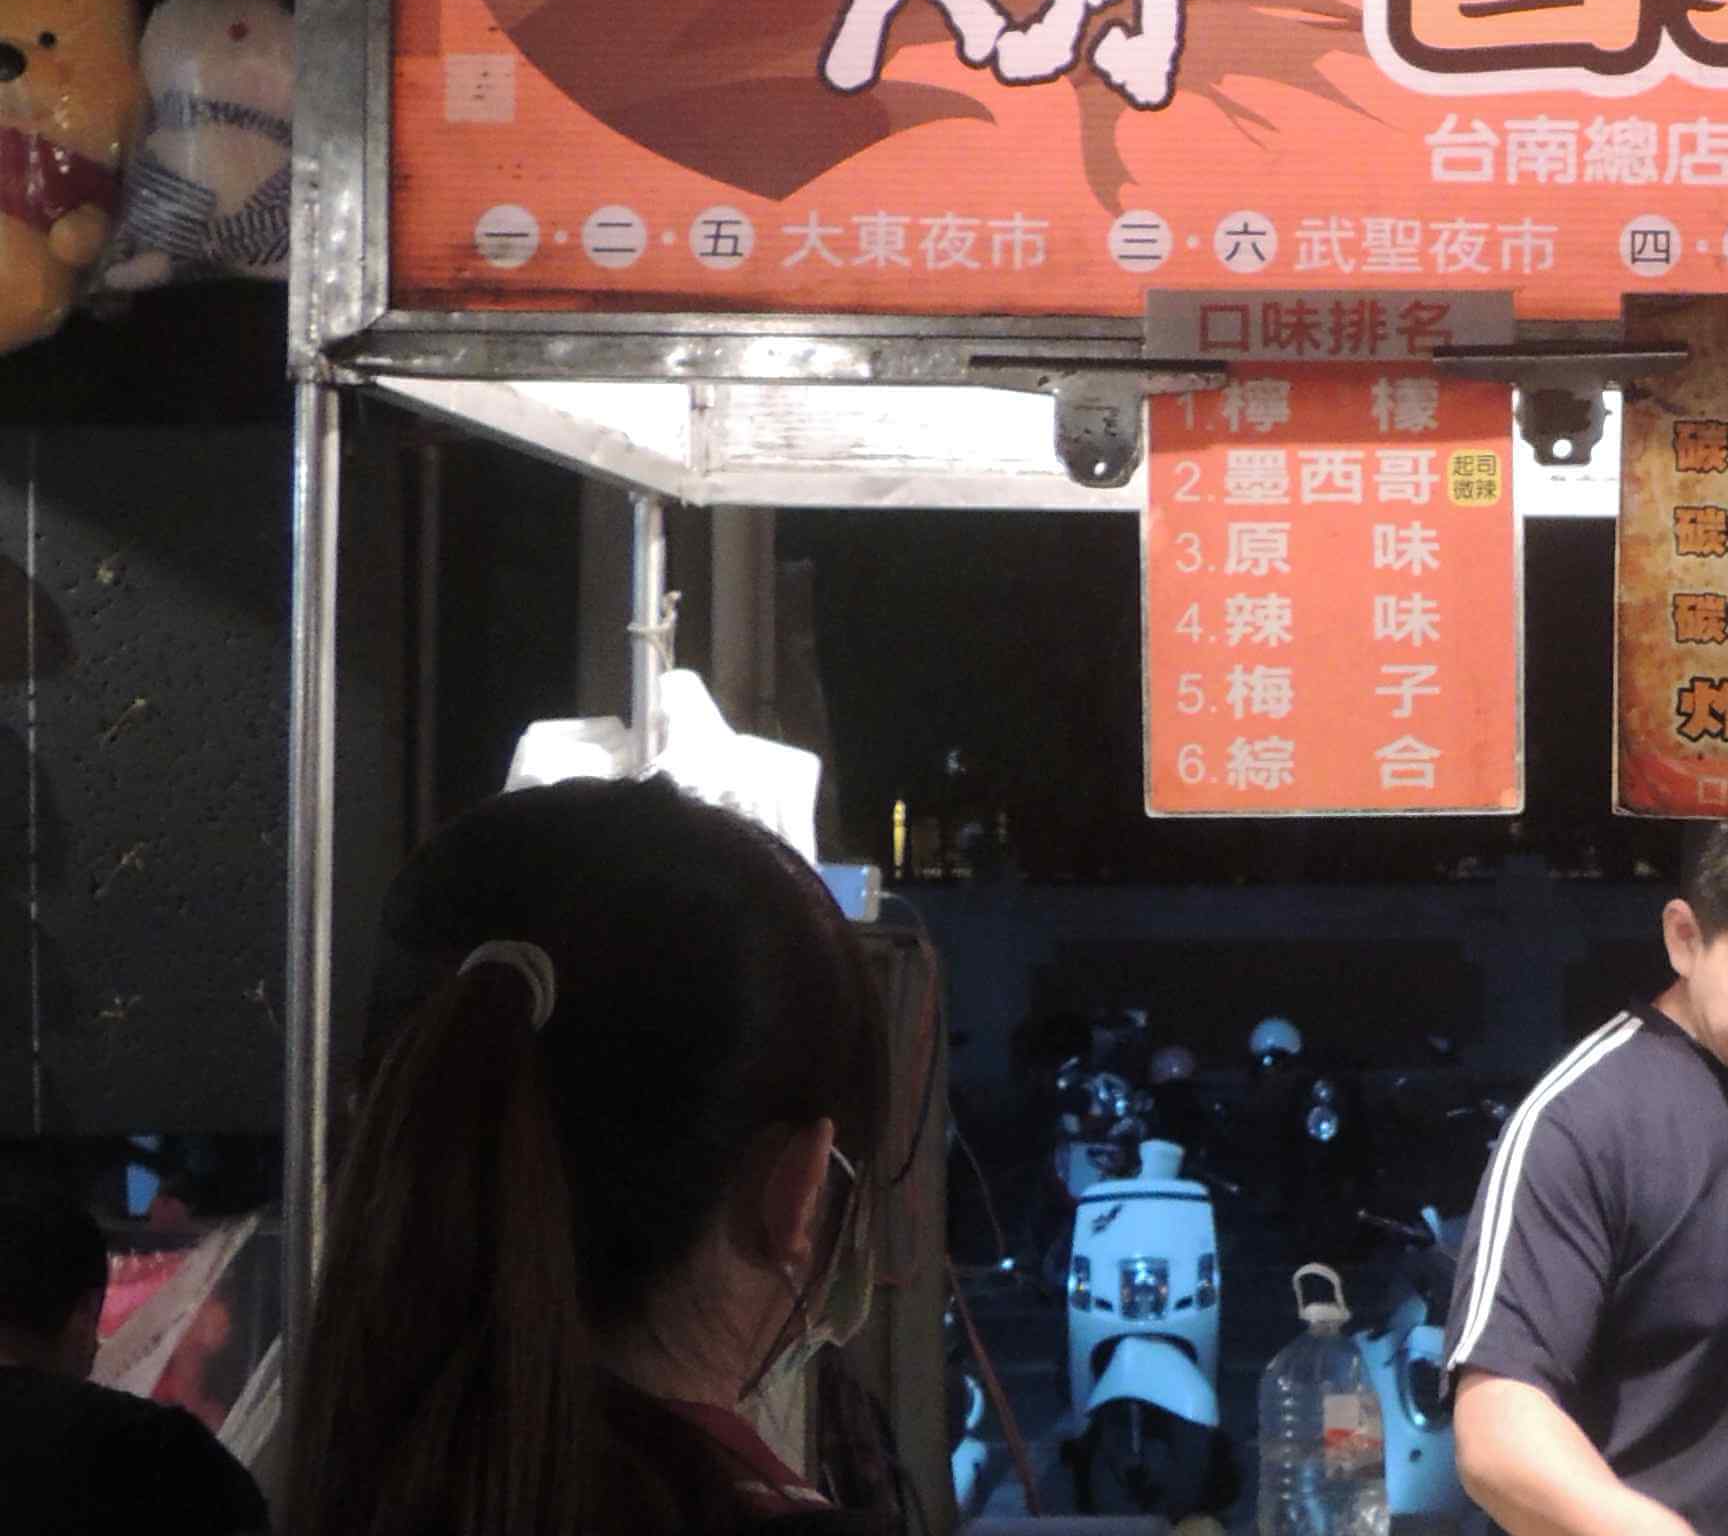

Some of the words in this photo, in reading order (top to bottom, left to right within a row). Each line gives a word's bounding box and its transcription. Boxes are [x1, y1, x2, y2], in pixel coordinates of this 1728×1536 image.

[781, 210, 1050, 270] 大東夜市
[1292, 216, 1559, 275] 武聖夜市
[1200, 300, 1454, 355] 口味排名
